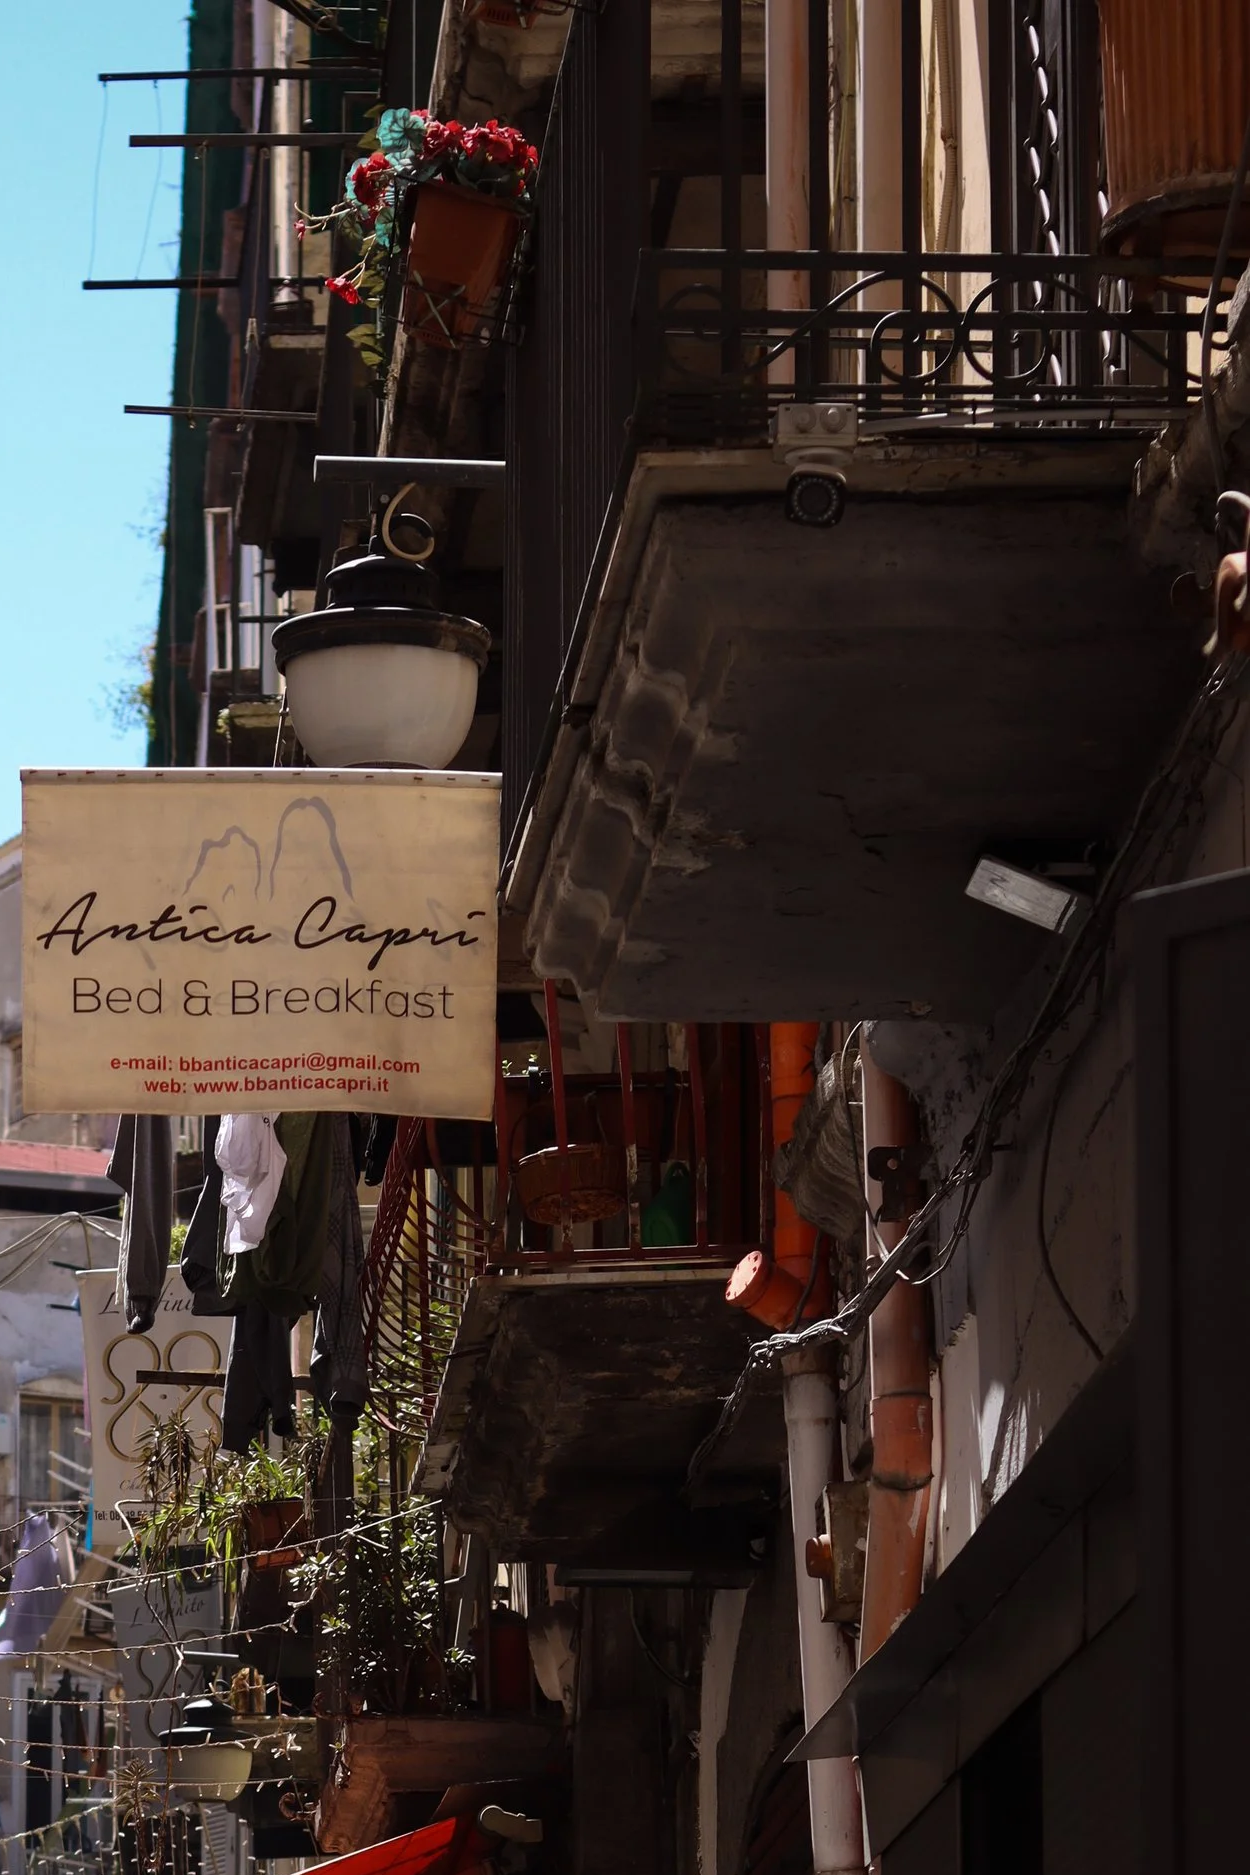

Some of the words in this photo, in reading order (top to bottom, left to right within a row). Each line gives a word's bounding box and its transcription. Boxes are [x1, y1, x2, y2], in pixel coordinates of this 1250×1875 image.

[37, 891, 272, 955] Antica
[293, 895, 486, 971] Capri
[72, 977, 163, 1015] Bed
[183, 979, 213, 1017] &
[231, 977, 455, 1020] Breakfast
[110, 1054, 174, 1072] e-mail:
[179, 1052, 421, 1075] bbanticacapri@gmail.com
[144, 1077, 188, 1095] web:
[193, 1075, 390, 1095] www.bbanticacapri.it
